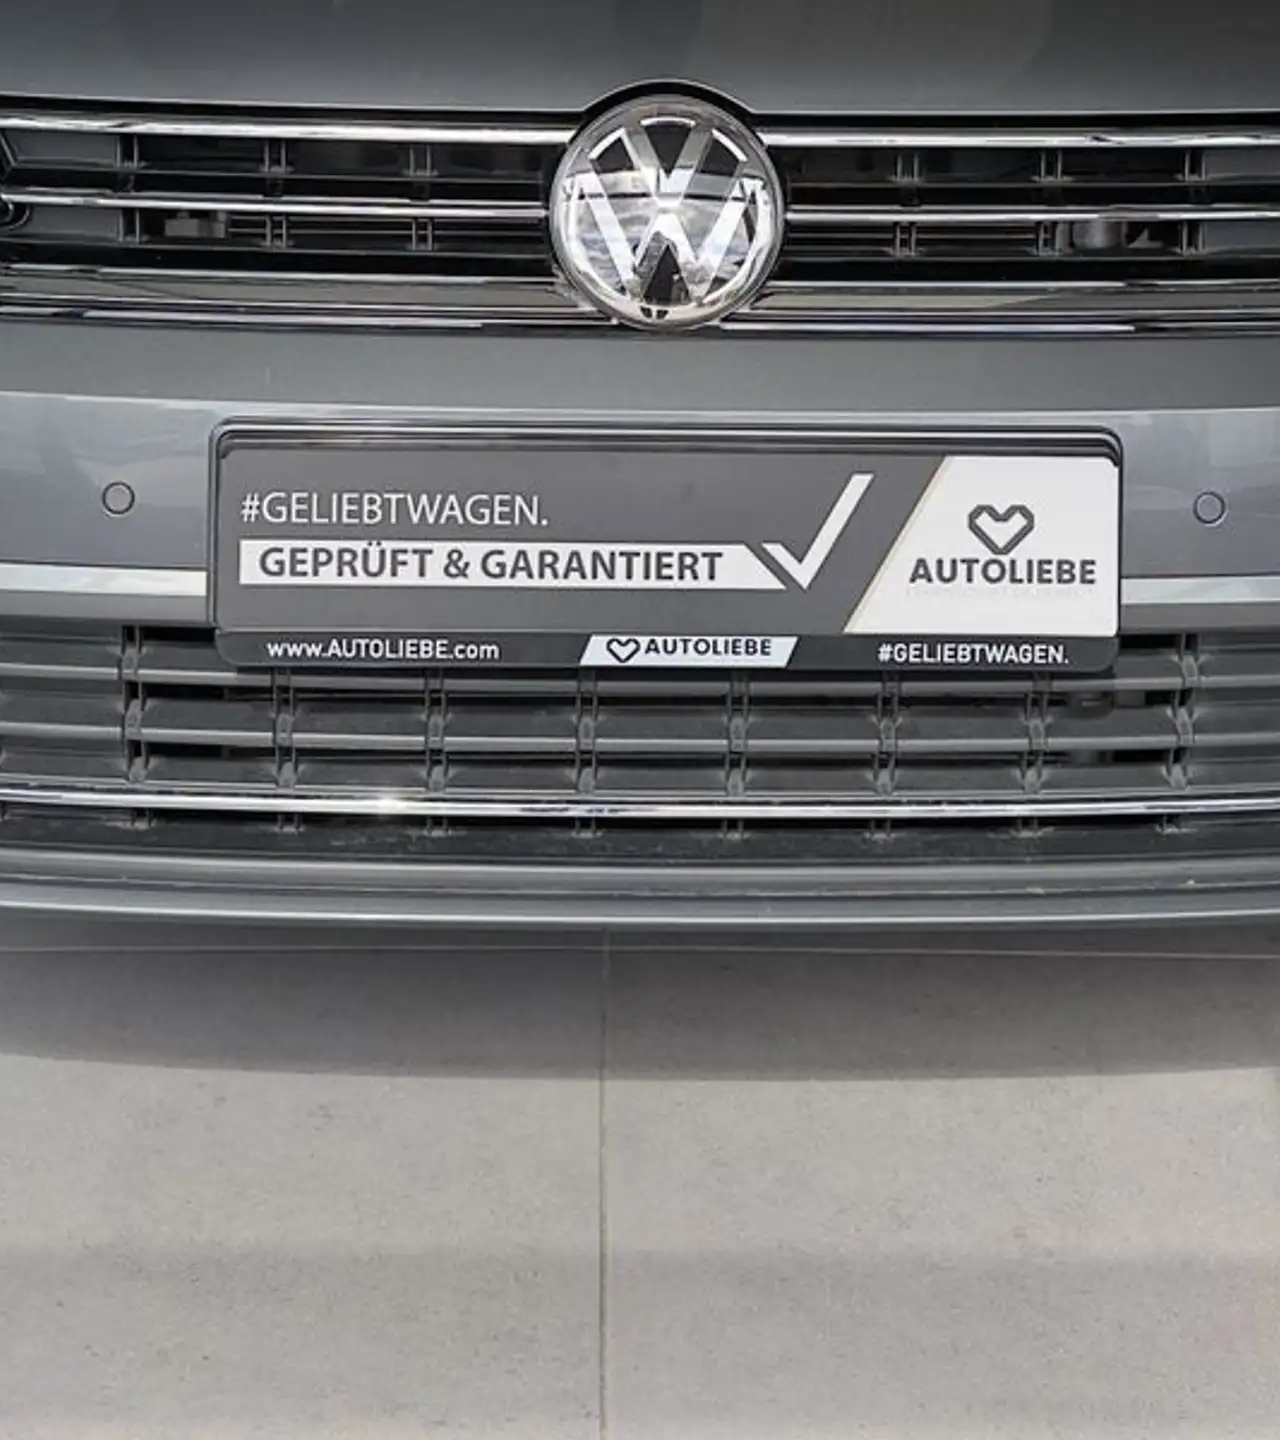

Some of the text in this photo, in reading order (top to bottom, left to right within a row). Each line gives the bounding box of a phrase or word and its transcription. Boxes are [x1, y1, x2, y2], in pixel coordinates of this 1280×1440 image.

[239, 490, 548, 527] #GELIEBTWAGEN.
[258, 541, 724, 582] GEPRÜFT & GARANTIERT
[908, 557, 1097, 585] AUTOLIEBE
[266, 637, 500, 660] www.AUTOLIEBE.com
[644, 636, 772, 657] AUTOLIEBE
[877, 643, 1069, 665] #GELIEBTWAGEN.
